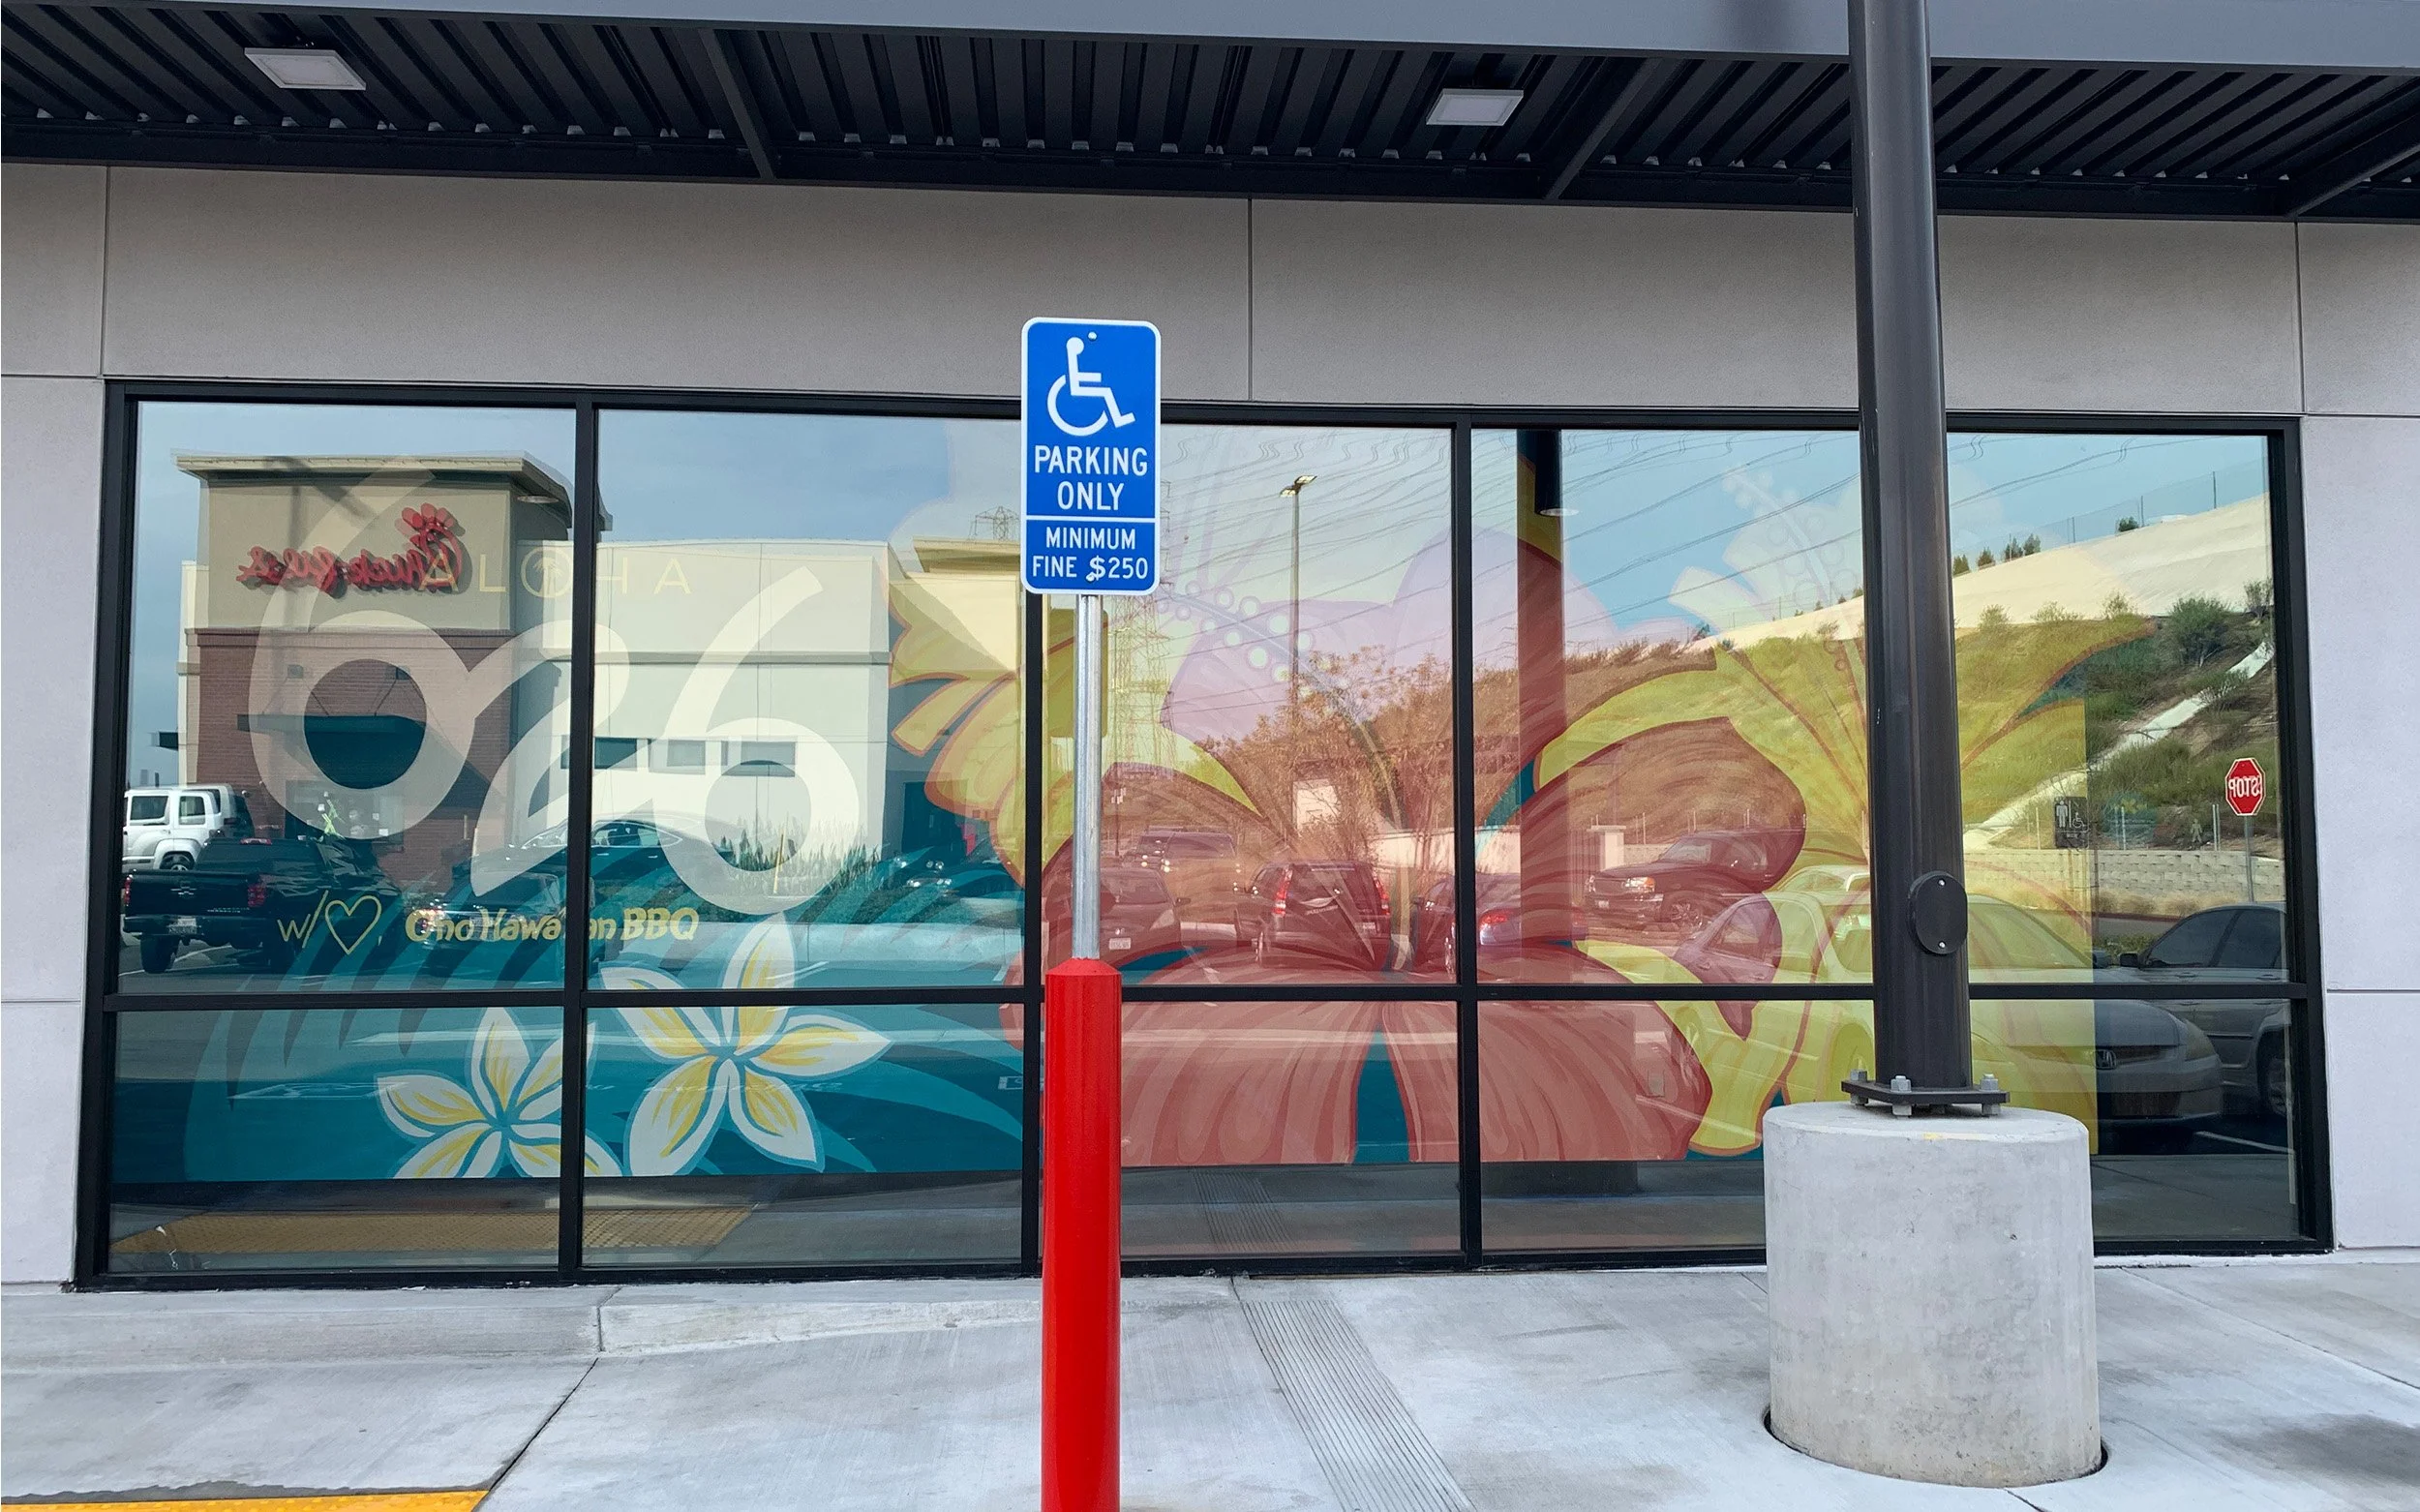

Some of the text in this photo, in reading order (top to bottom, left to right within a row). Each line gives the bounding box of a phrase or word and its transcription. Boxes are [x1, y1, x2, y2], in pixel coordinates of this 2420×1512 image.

[1034, 444, 1148, 476] PARKING
[1057, 480, 1125, 511] ONLY
[1045, 526, 1136, 550] MINIMUM
[419, 546, 692, 598] ALOHA
[1032, 554, 1149, 581] FINE $250
[406, 909, 474, 941] Ono
[479, 908, 617, 940] Hawan
[620, 907, 699, 941] BBQ
